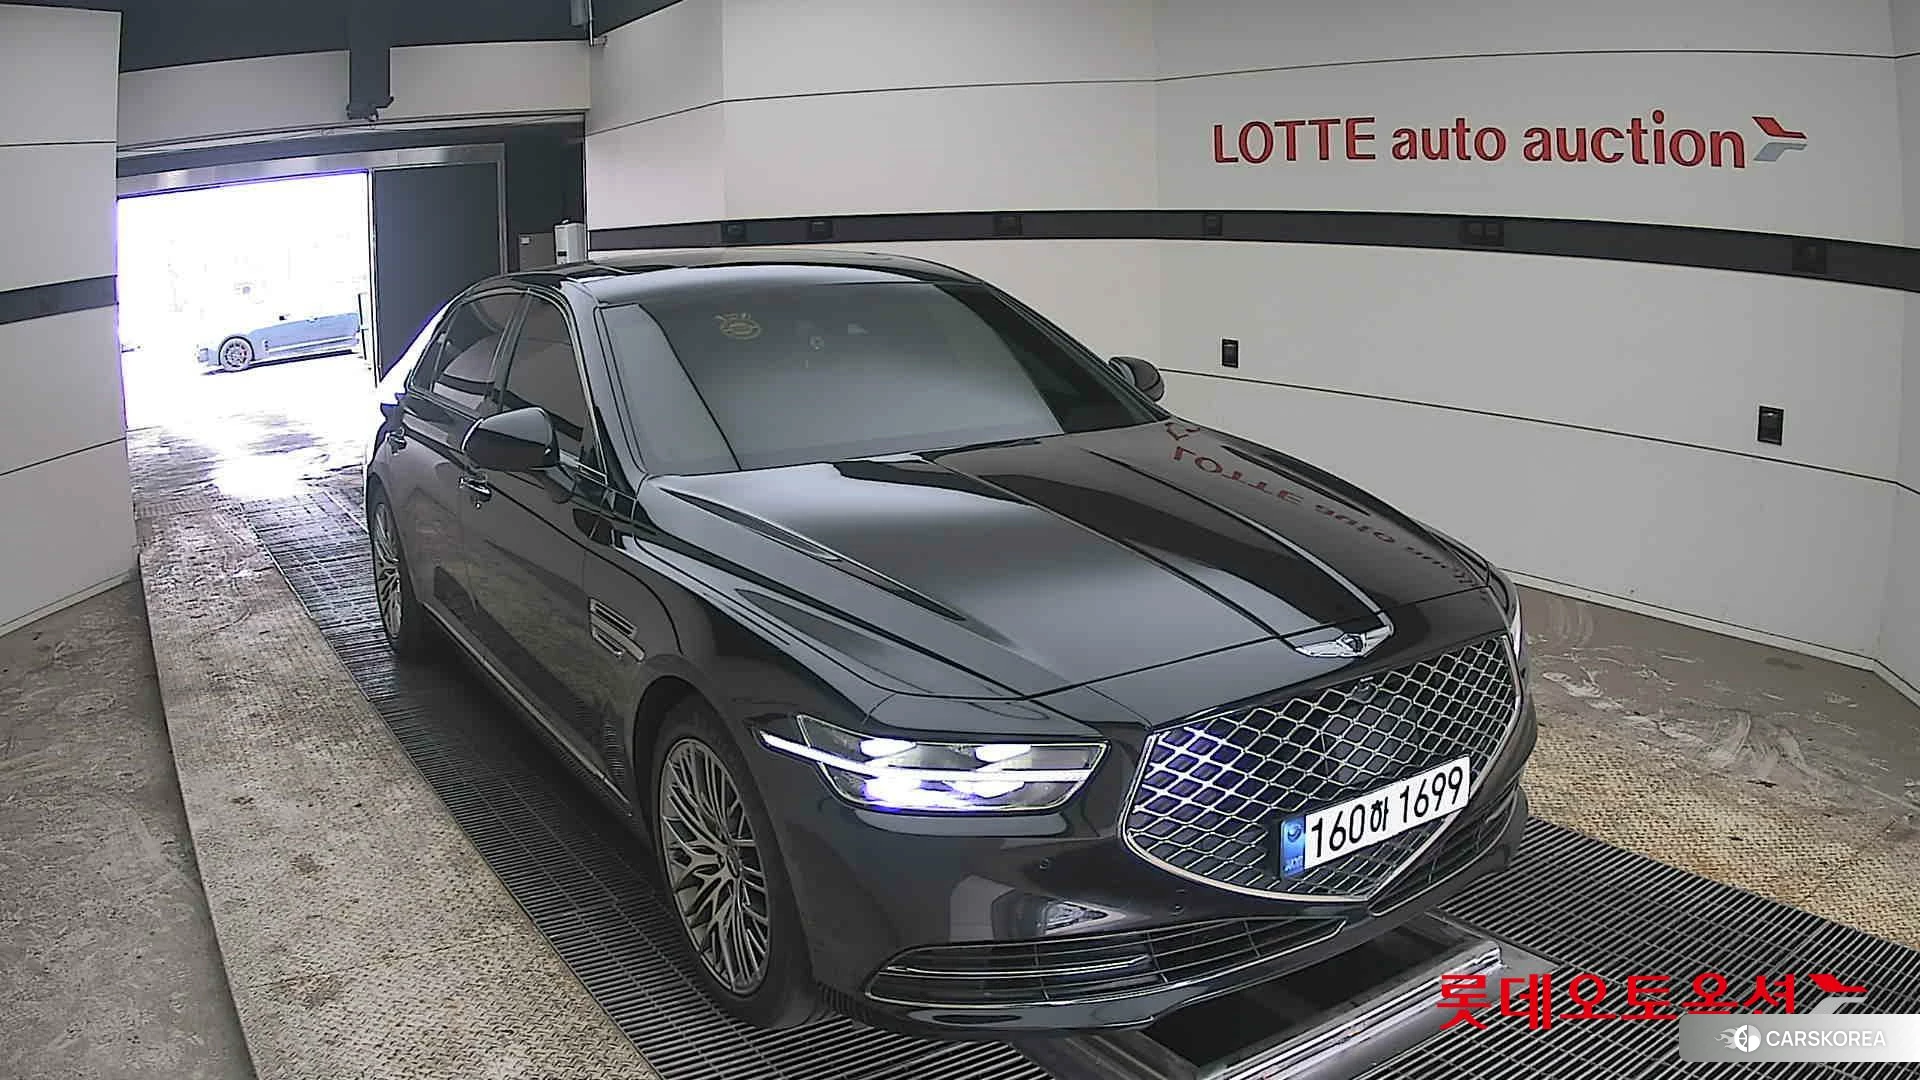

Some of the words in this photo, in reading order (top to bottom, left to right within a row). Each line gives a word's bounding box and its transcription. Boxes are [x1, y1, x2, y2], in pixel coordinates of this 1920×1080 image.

[1213, 116, 1376, 163] LOTTE
[1391, 117, 1507, 161] auto
[1522, 109, 1746, 168] auction
[1311, 795, 1389, 858] 160하
[1399, 765, 1464, 824] 1699
